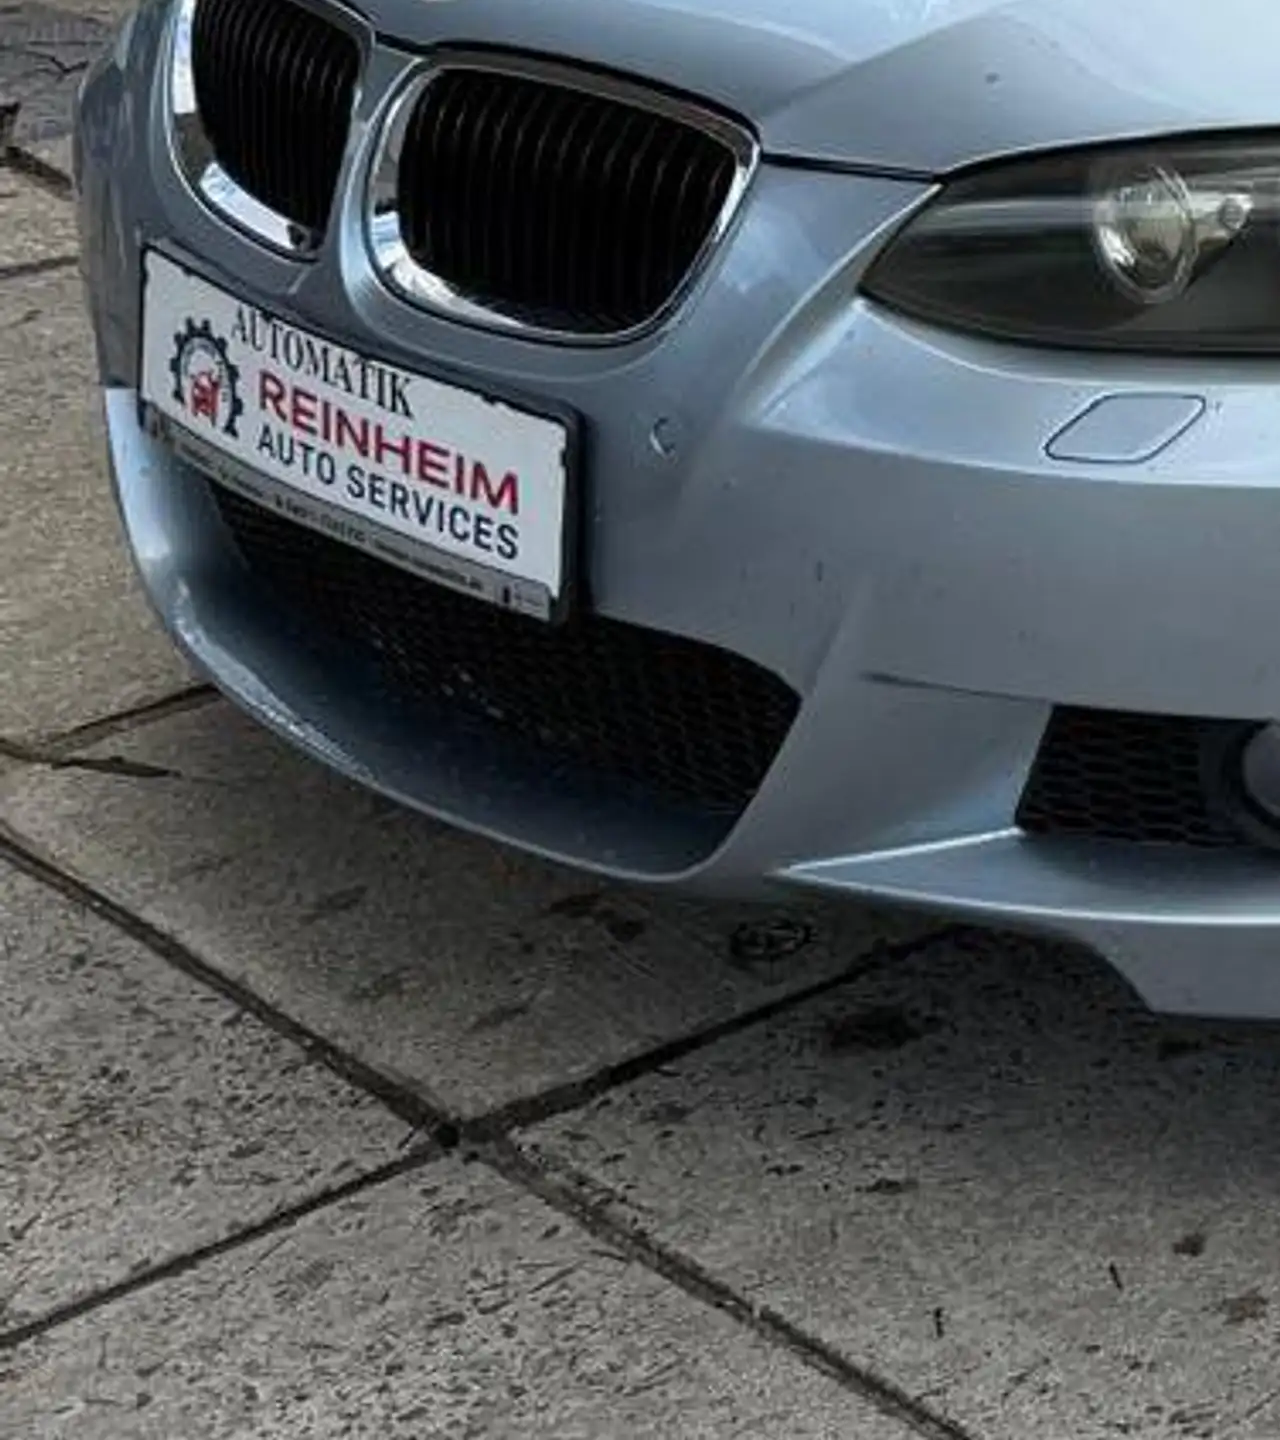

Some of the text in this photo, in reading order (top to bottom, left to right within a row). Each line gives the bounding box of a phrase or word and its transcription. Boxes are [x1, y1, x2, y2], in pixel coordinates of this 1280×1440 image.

[232, 305, 414, 419] AUTOMATIK
[256, 423, 337, 487] AUTO
[345, 464, 521, 561] SERVICES
[258, 370, 520, 516] REINHEIM
